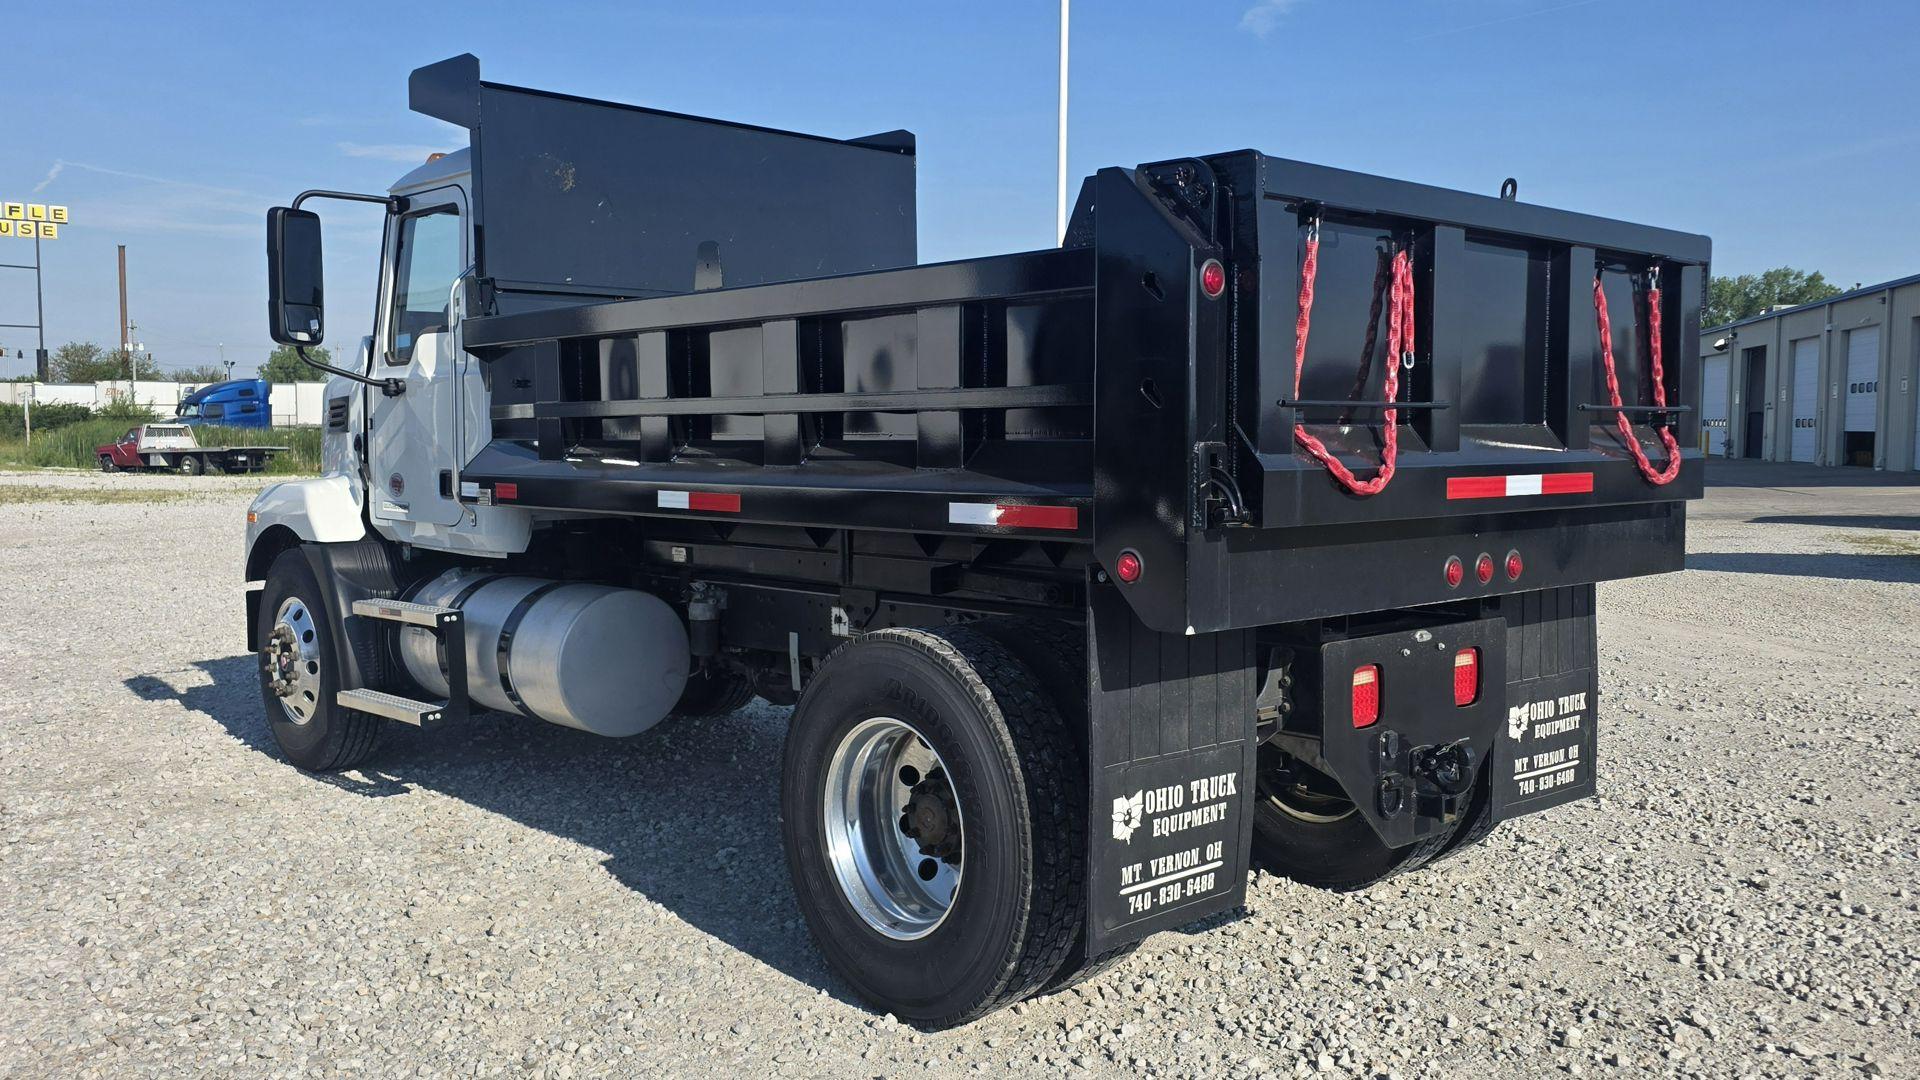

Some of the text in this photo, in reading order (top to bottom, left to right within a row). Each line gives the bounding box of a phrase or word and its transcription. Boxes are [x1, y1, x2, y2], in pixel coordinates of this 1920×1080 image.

[0, 222, 54, 237] USE
[1530, 692, 1587, 721] OHIO TRUCK
[1534, 715, 1581, 739] EQUIPMENT
[1568, 744, 1579, 760] OH
[1145, 772, 1237, 814] OHIO TRUCK
[1152, 802, 1227, 837] EQUIPMENT
[1206, 840, 1223, 861] OH
[1128, 872, 1215, 915] 740-830-6488
